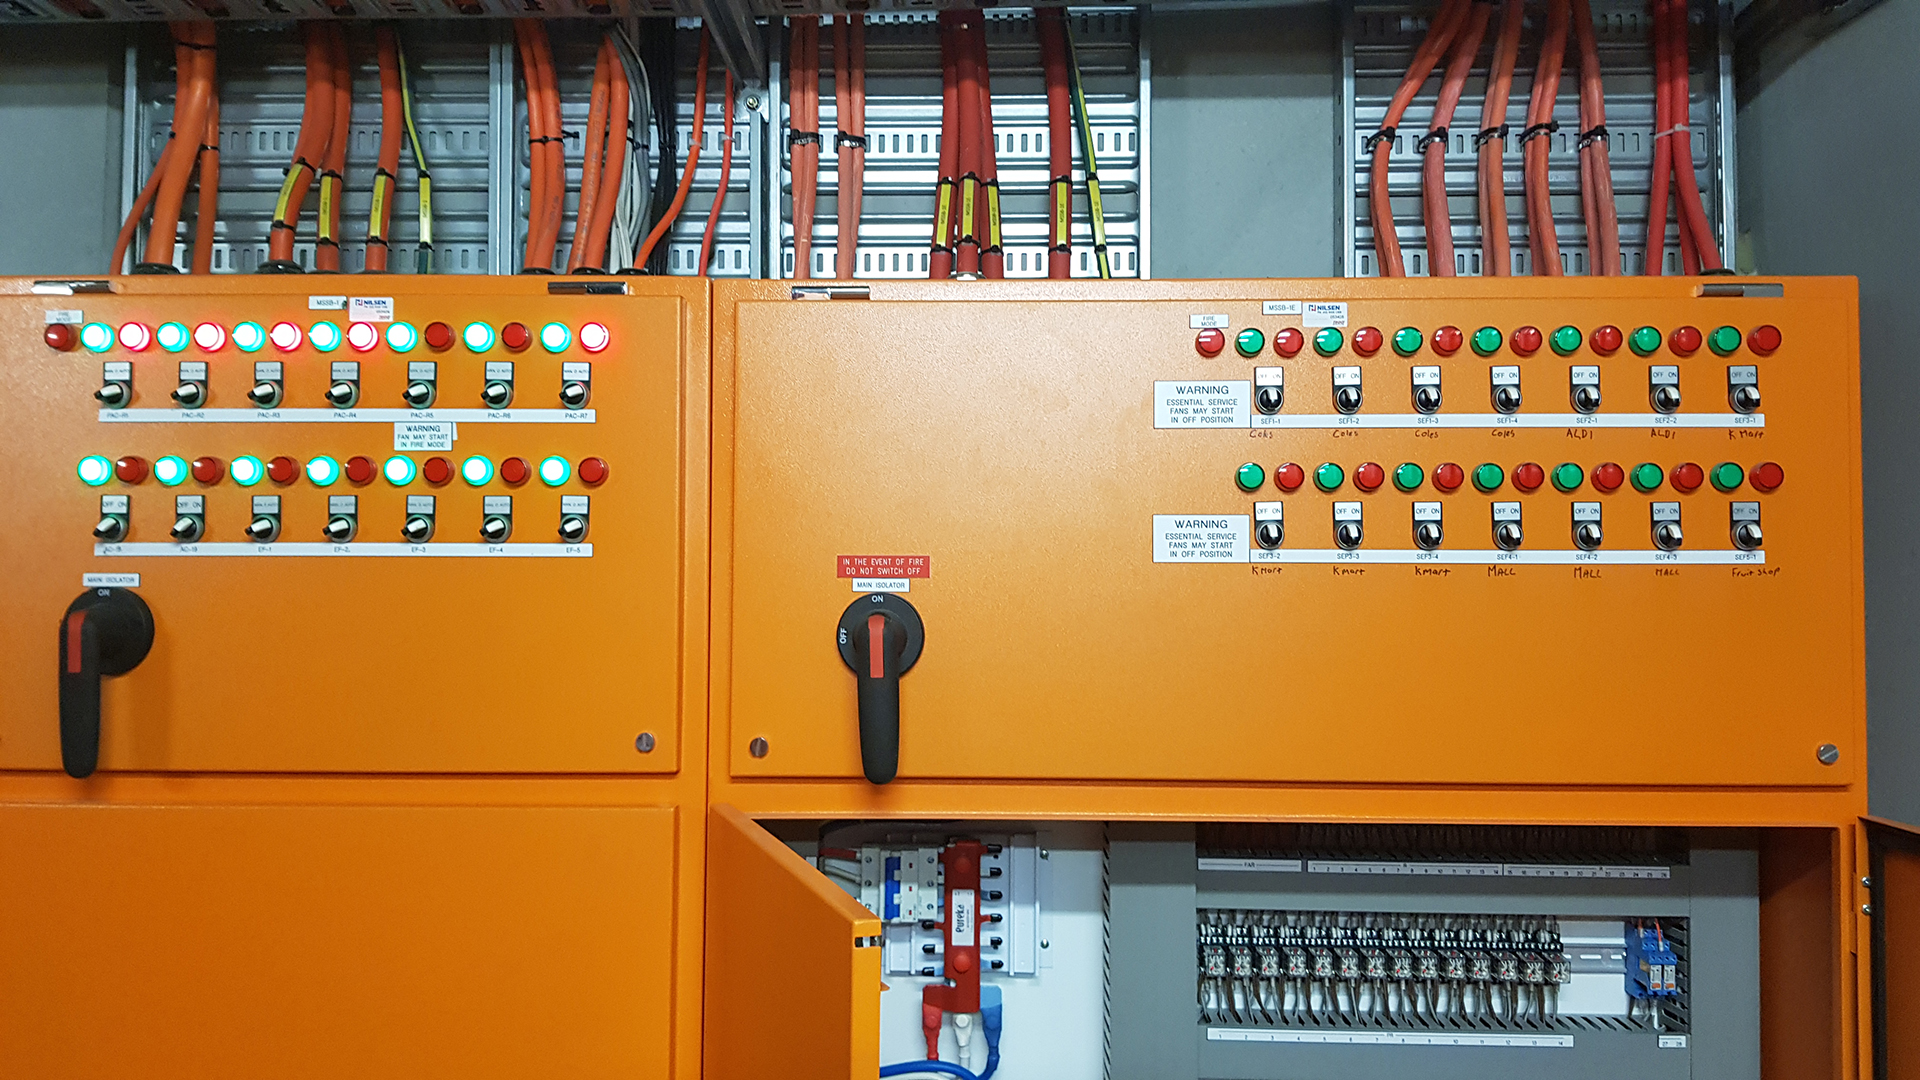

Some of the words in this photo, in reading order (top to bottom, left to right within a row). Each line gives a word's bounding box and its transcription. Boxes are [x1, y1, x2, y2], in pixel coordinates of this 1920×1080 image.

[1175, 386, 1229, 395] WARNING
[1166, 398, 1204, 406] ESSENTIAL
[1208, 398, 1238, 406] SERVICE
[1169, 407, 1189, 415] FANS
[1192, 407, 1208, 415] MAY
[1211, 407, 1234, 415] START
[1170, 416, 1178, 424] IN
[1182, 416, 1197, 424] OFF
[1200, 416, 1234, 424] POSITION
[405, 425, 441, 433] WARNING
[397, 433, 411, 441] FAN
[413, 433, 426, 441] MAY
[429, 433, 449, 441] START
[1332, 429, 1359, 438] Coles
[1414, 429, 1439, 439] Coles
[1491, 429, 1516, 438] Coles
[1174, 520, 1228, 529] WARNING
[1168, 541, 1188, 549] FANS
[1191, 541, 1207, 549] MAY
[1210, 541, 1234, 549] START
[1169, 550, 1178, 558] IN
[1181, 550, 1196, 558] OFF
[1199, 550, 1233, 558] POSITION
[846, 567, 856, 575] DO
[860, 567, 874, 575] NOT
[877, 567, 903, 575] SWITCH
[907, 567, 921, 575] OFF
[1573, 567, 1602, 579] MALL
[1655, 568, 1680, 576] MALL
[1732, 567, 1755, 578] Fruit
[97, 588, 111, 597] ON
[871, 595, 884, 603] ON
[839, 627, 847, 644] OFF
